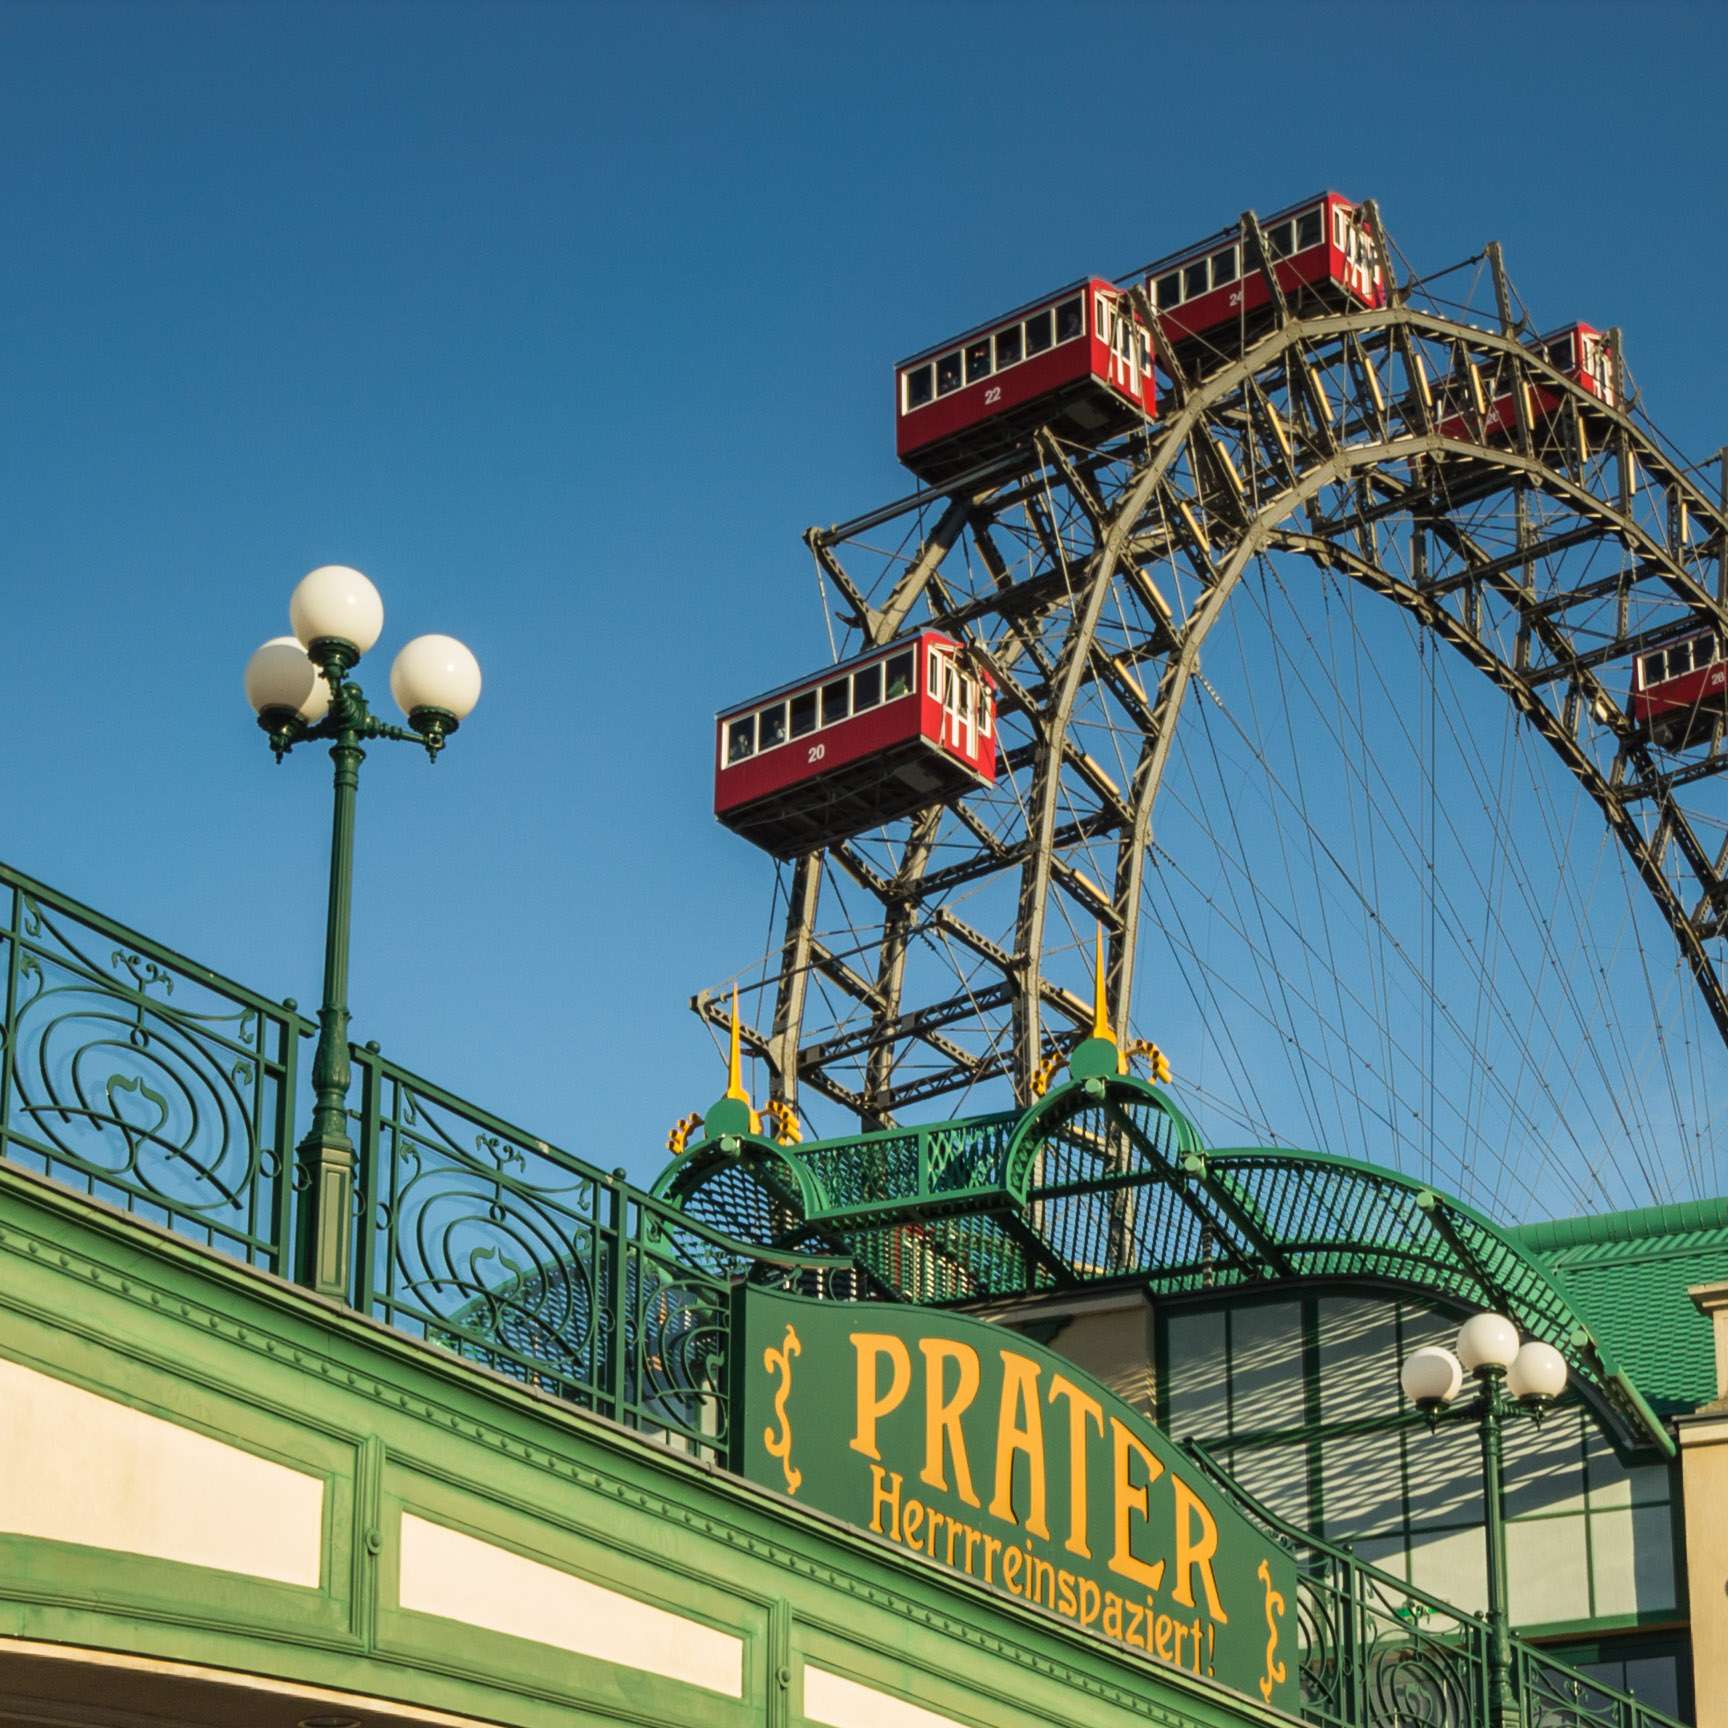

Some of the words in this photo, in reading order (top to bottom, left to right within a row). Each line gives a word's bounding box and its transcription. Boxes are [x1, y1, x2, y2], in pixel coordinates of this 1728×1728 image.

[984, 387, 1001, 405] 22
[808, 744, 825, 763] 20
[849, 1333, 1226, 1624] PRATER
